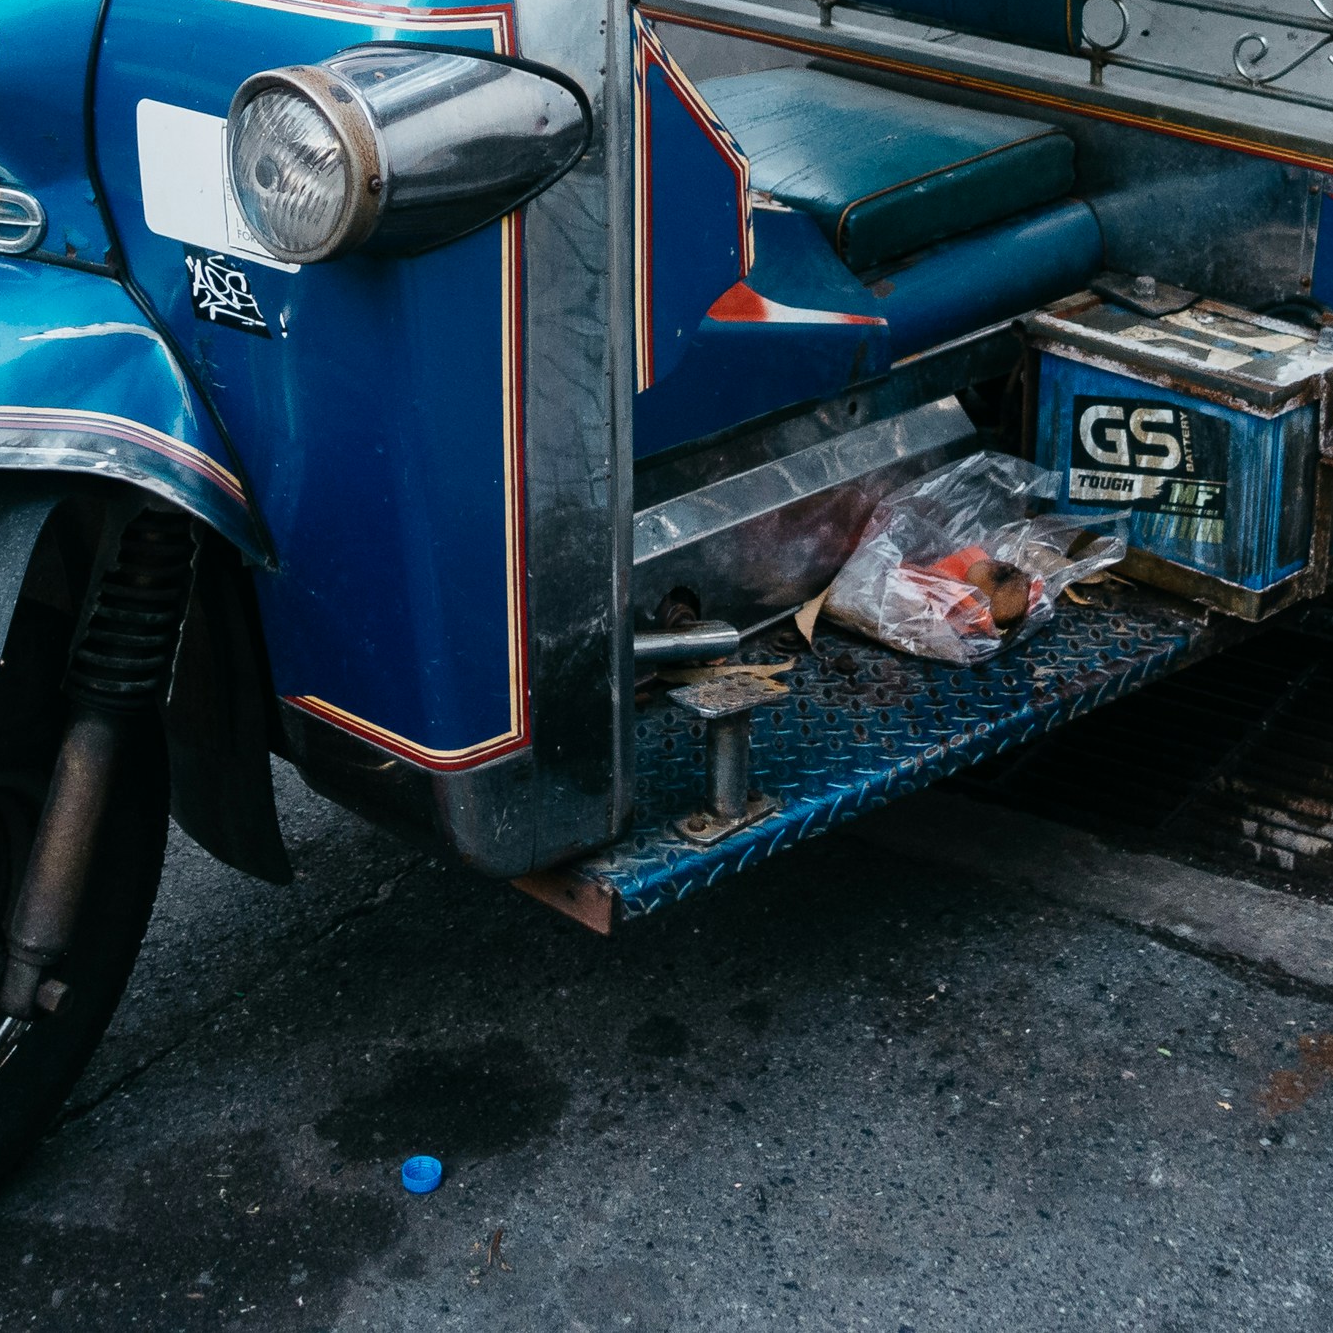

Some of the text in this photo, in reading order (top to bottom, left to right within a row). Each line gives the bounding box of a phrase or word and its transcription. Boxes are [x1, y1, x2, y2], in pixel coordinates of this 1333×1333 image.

[1079, 404, 1182, 470] GS
[1179, 411, 1195, 473] BATTERY
[1078, 474, 1135, 493] TOUGH
[1169, 483, 1221, 507] MF
